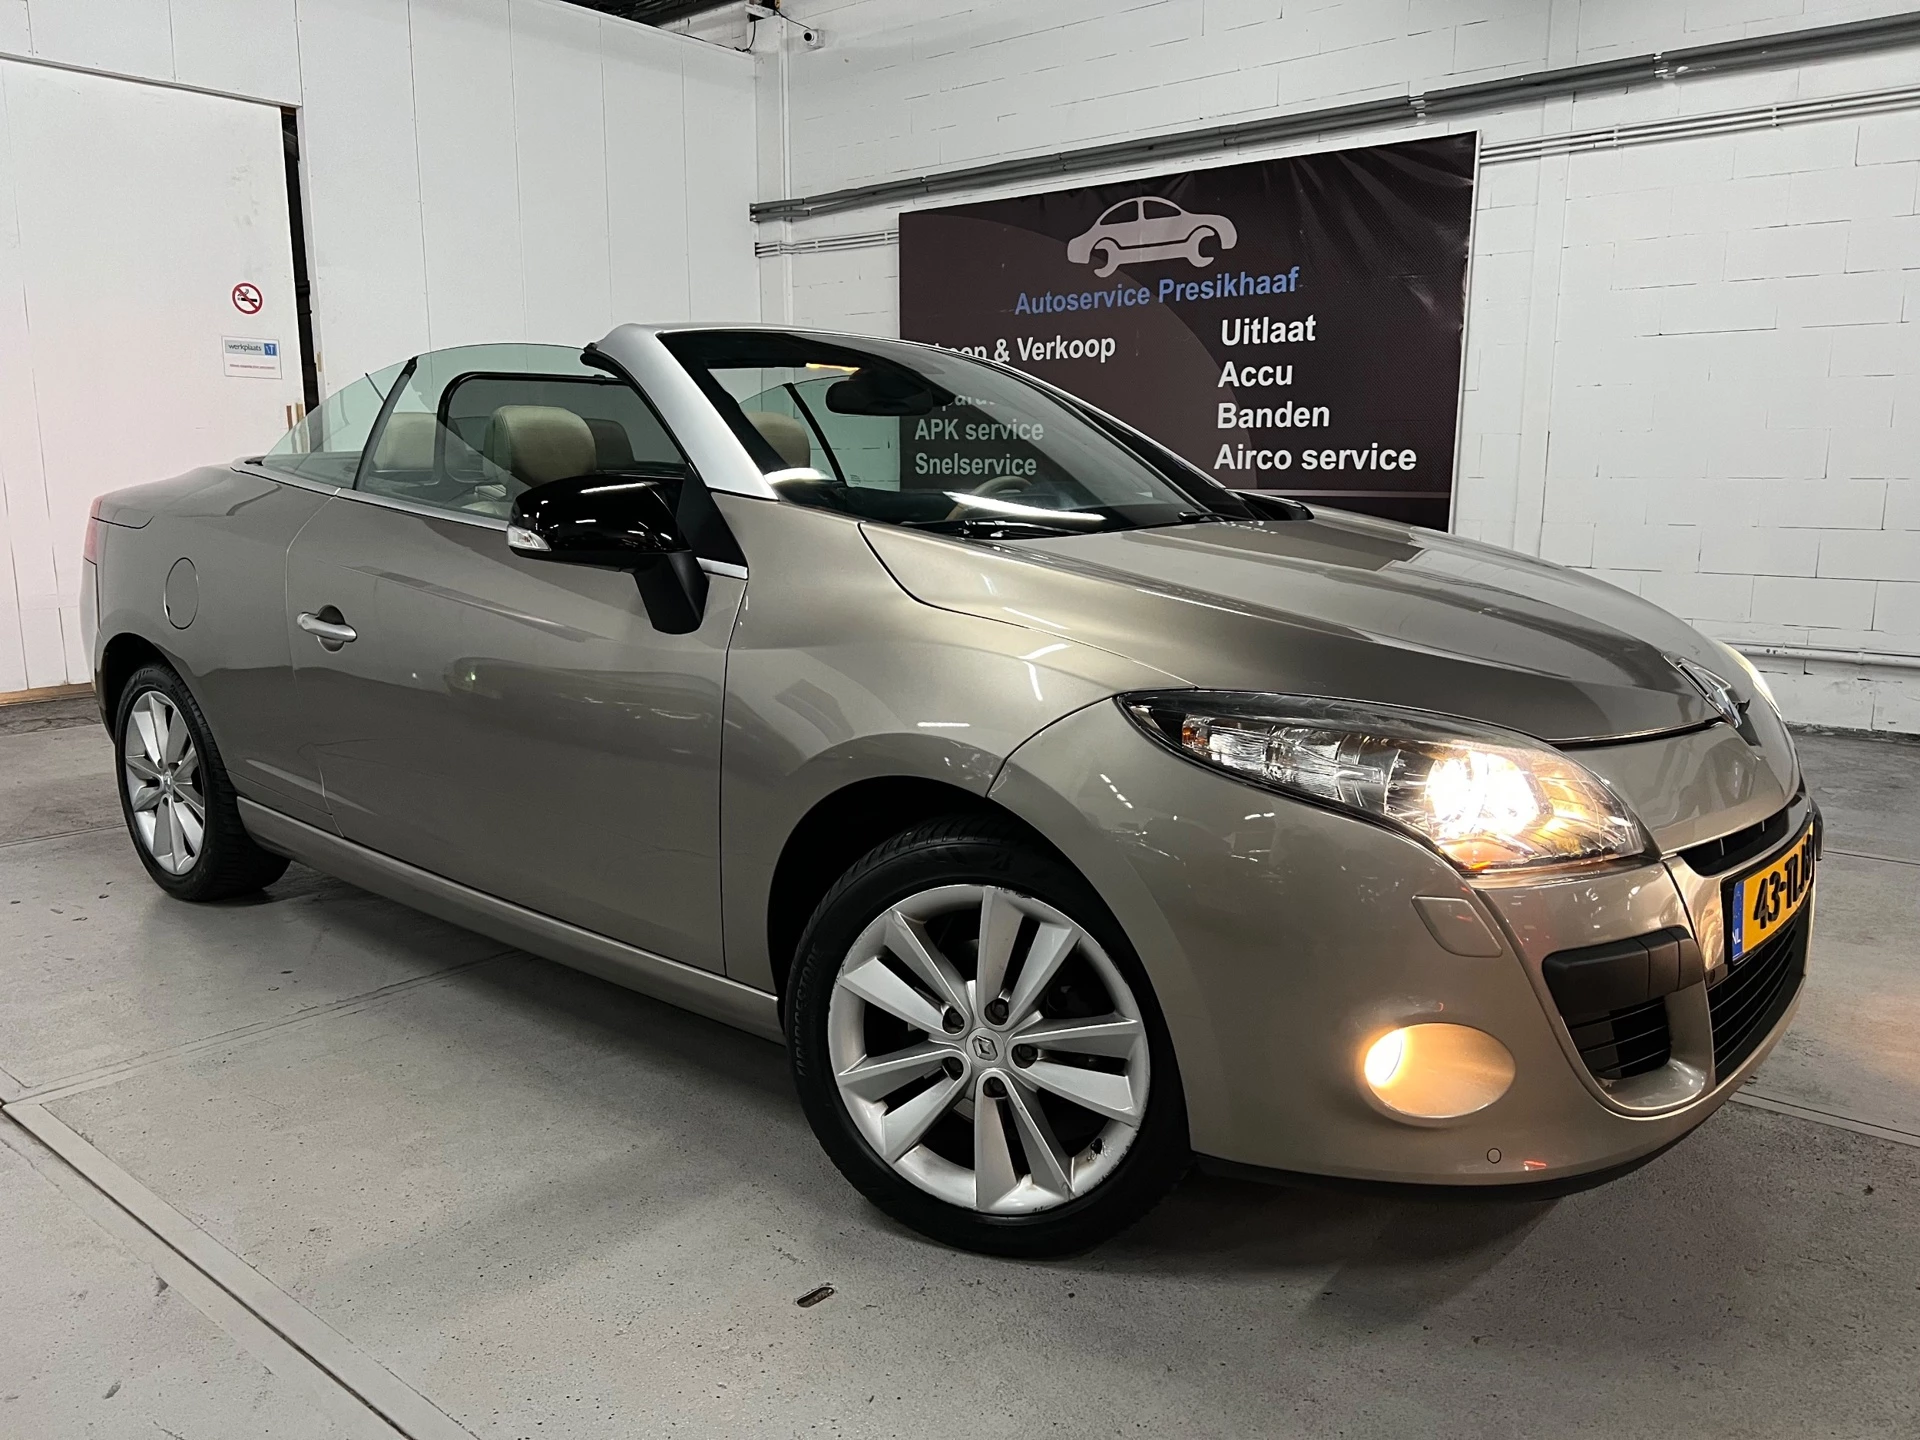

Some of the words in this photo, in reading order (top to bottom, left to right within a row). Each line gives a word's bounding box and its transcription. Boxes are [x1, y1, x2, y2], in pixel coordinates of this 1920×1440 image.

[1014, 284, 1150, 315] Autoservice
[1158, 266, 1300, 303] Presikhaaf
[1221, 314, 1317, 346] Uitlaat
[228, 344, 262, 352] werkplaats
[994, 338, 1010, 363] &
[1016, 335, 1116, 363] Verkoop
[1217, 361, 1293, 388] Accu
[1217, 401, 1330, 429] Banden
[914, 418, 960, 440] APK
[965, 418, 1044, 441] service
[915, 452, 1037, 476] Snelservice
[1213, 443, 1292, 470] Airco
[1301, 442, 1417, 471] service
